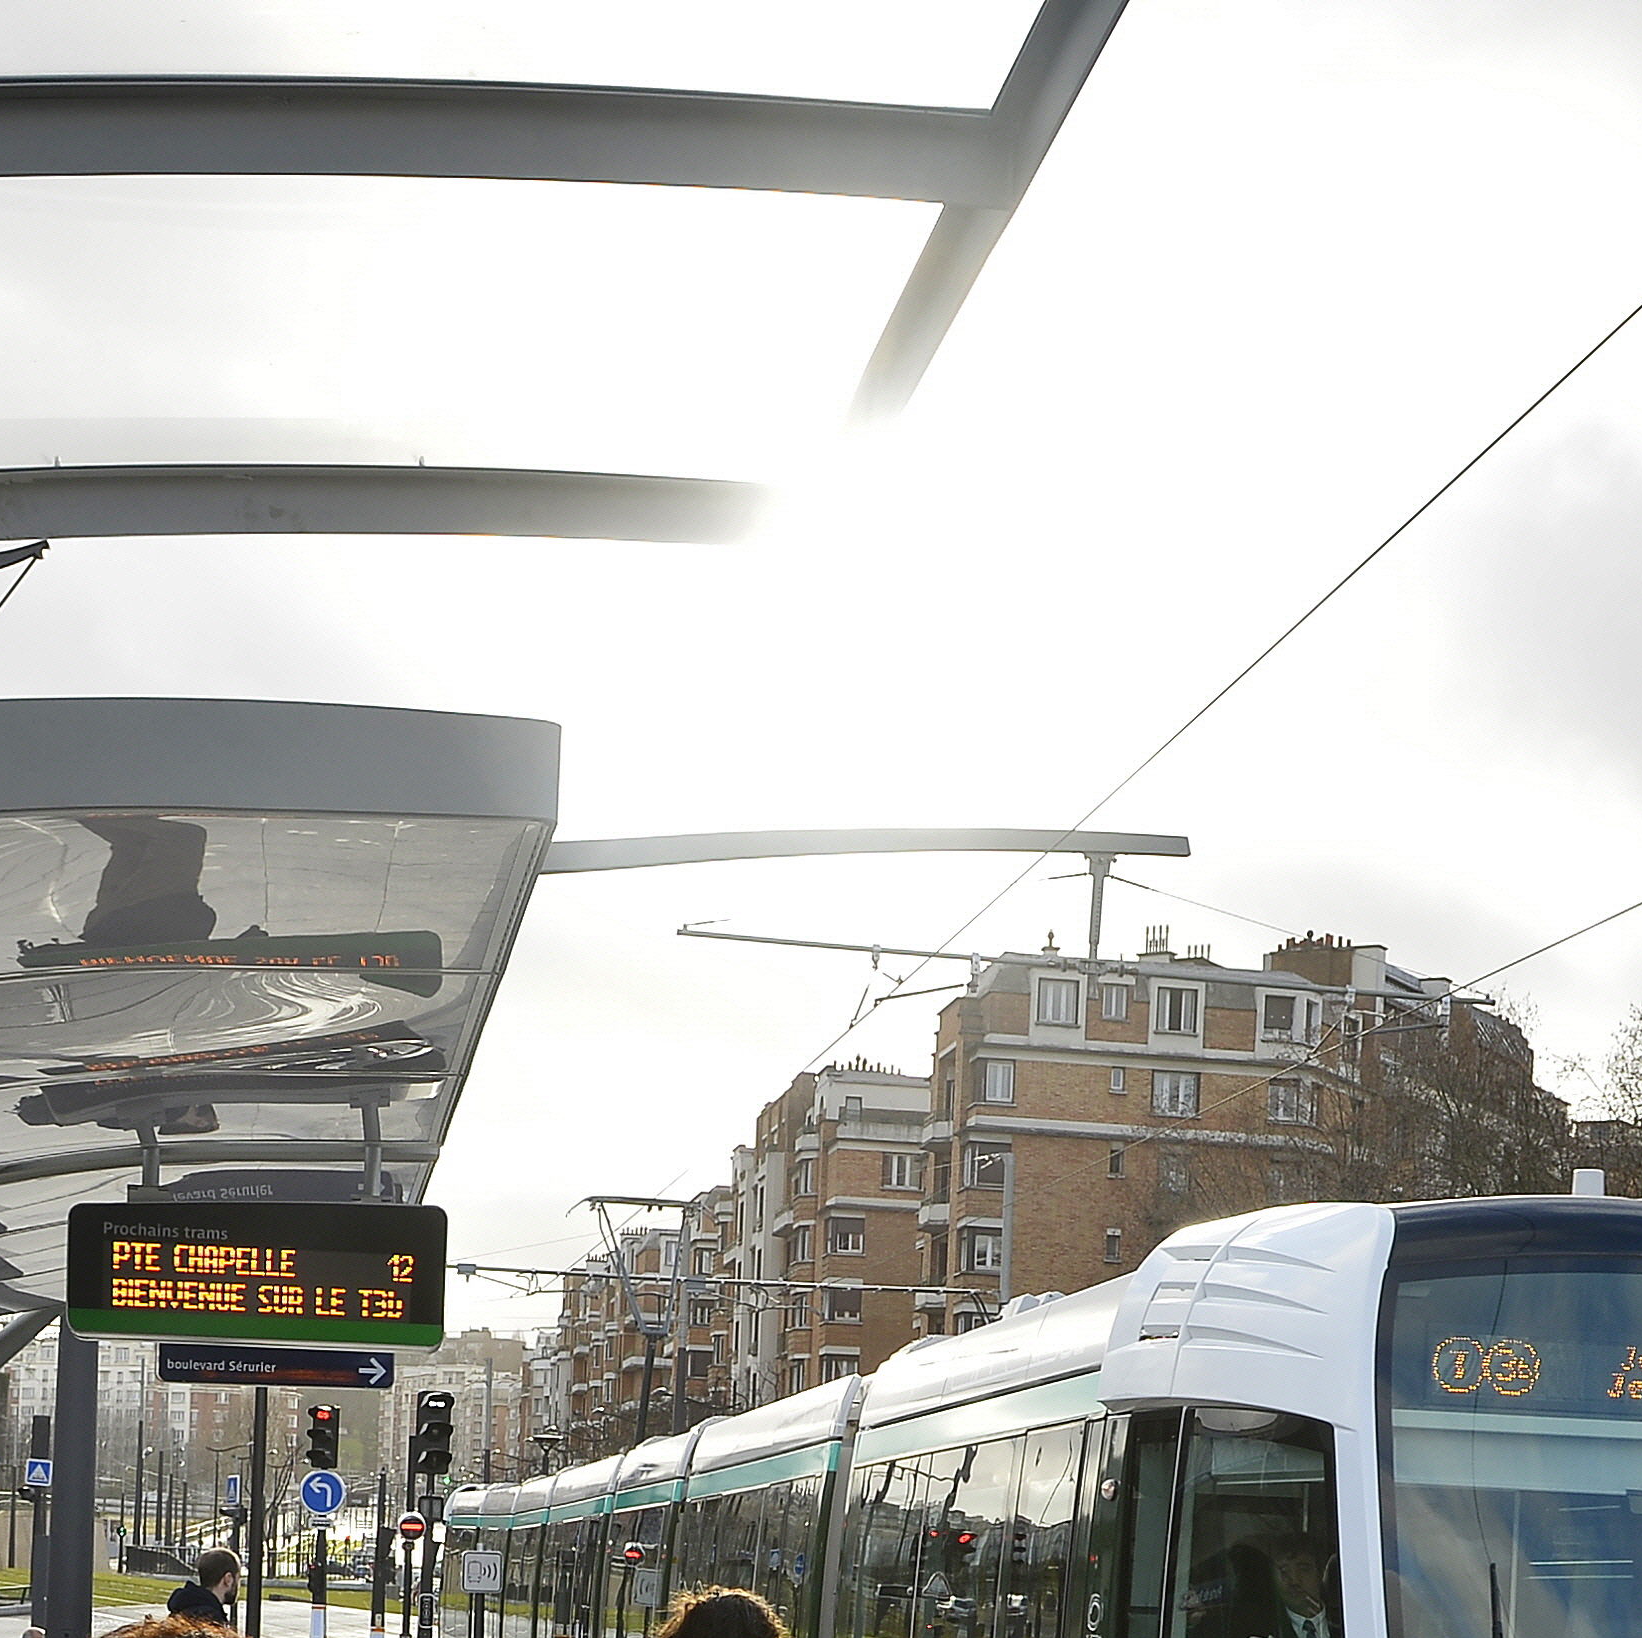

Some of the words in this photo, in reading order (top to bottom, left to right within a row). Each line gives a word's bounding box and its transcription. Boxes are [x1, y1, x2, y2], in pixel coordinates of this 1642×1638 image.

[103, 1222, 179, 1238] Prochains
[185, 1226, 228, 1240] trams
[112, 1241, 162, 1271] PTE
[173, 1244, 296, 1277] CHAPELLE
[386, 1254, 414, 1283] 12
[112, 1277, 247, 1312] BIENVENUE
[257, 1284, 304, 1314] SUR
[314, 1287, 347, 1317] LE
[166, 1358, 225, 1371] boulevard
[228, 1359, 277, 1373] Sérurier
